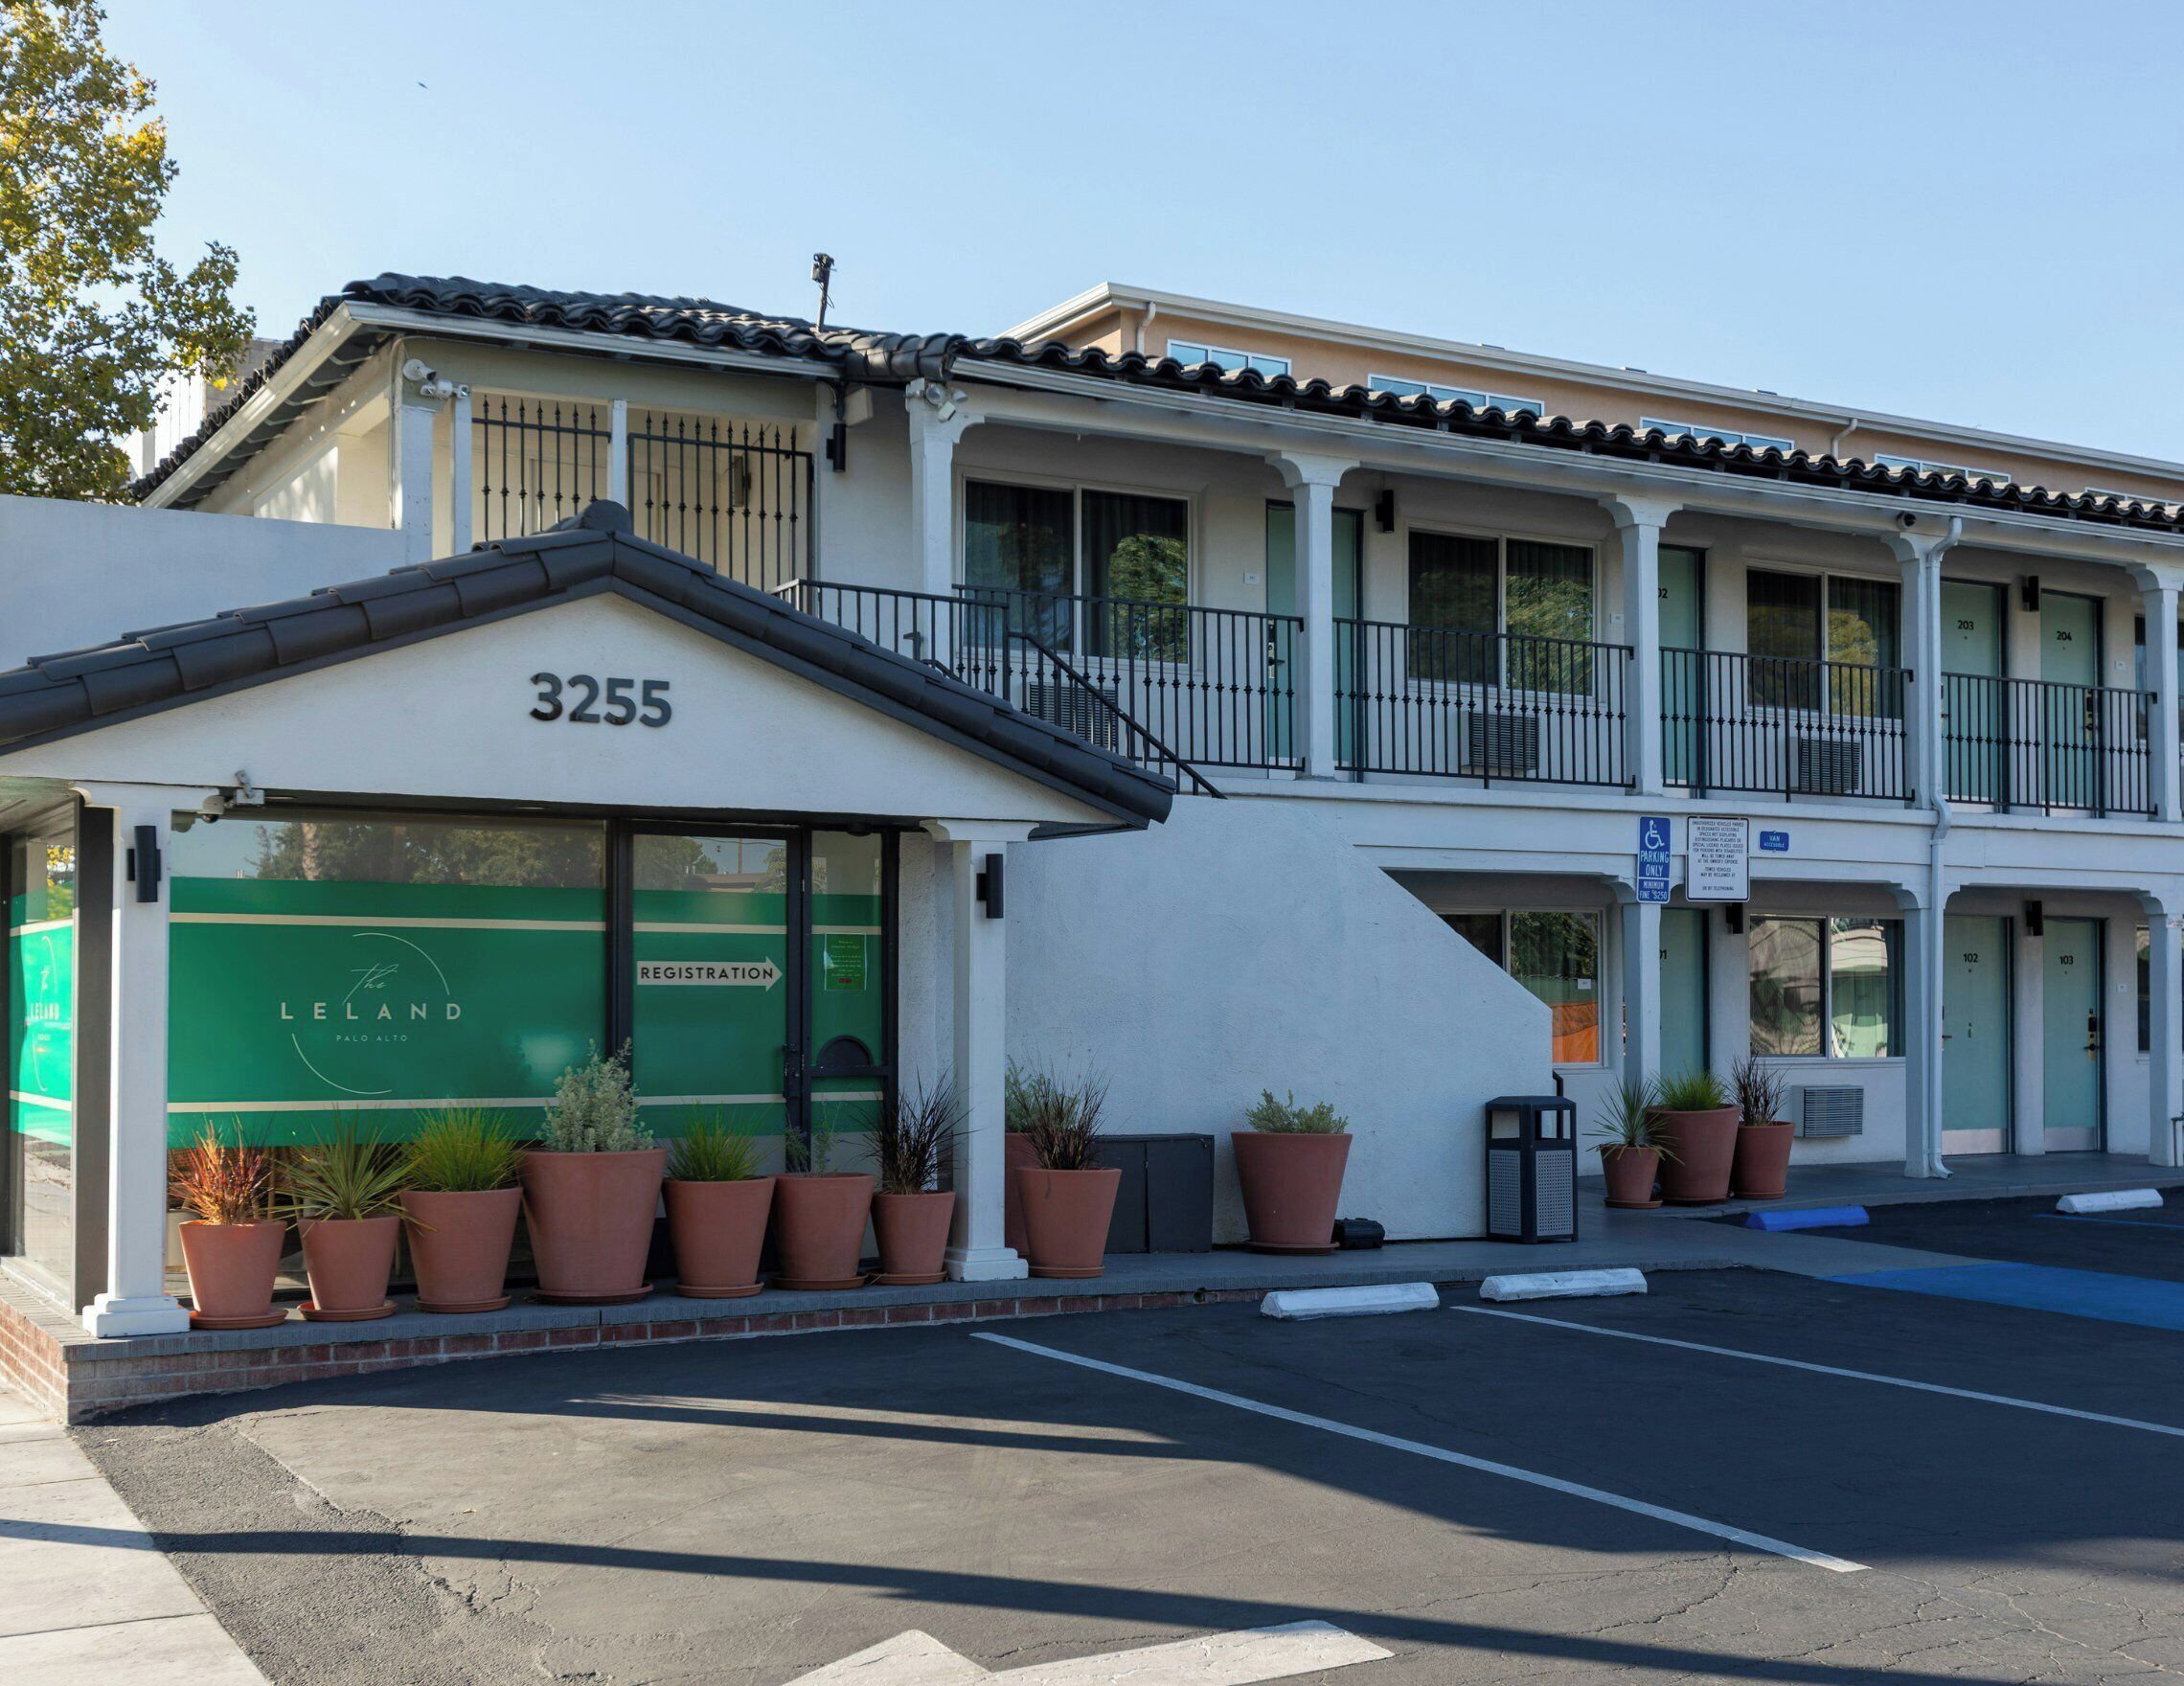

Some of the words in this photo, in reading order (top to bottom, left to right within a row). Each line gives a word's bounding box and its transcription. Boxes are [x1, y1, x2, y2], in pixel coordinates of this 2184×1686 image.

[1957, 620, 1974, 630] 203
[2056, 631, 2072, 641] 204
[530, 672, 672, 728] 3255
[1640, 850, 1669, 863] PARKING
[1646, 864, 1663, 876] ONLY
[1644, 881, 1664, 889] MINIMUM
[1640, 890, 1650, 899] FINE
[1654, 891, 1667, 900] $250
[1963, 953, 1978, 963] 102
[2059, 956, 2074, 965] 103
[641, 967, 773, 979] REGISTRATION
[30, 1002, 60, 1020] LELAND
[281, 1002, 461, 1020] LELAND
